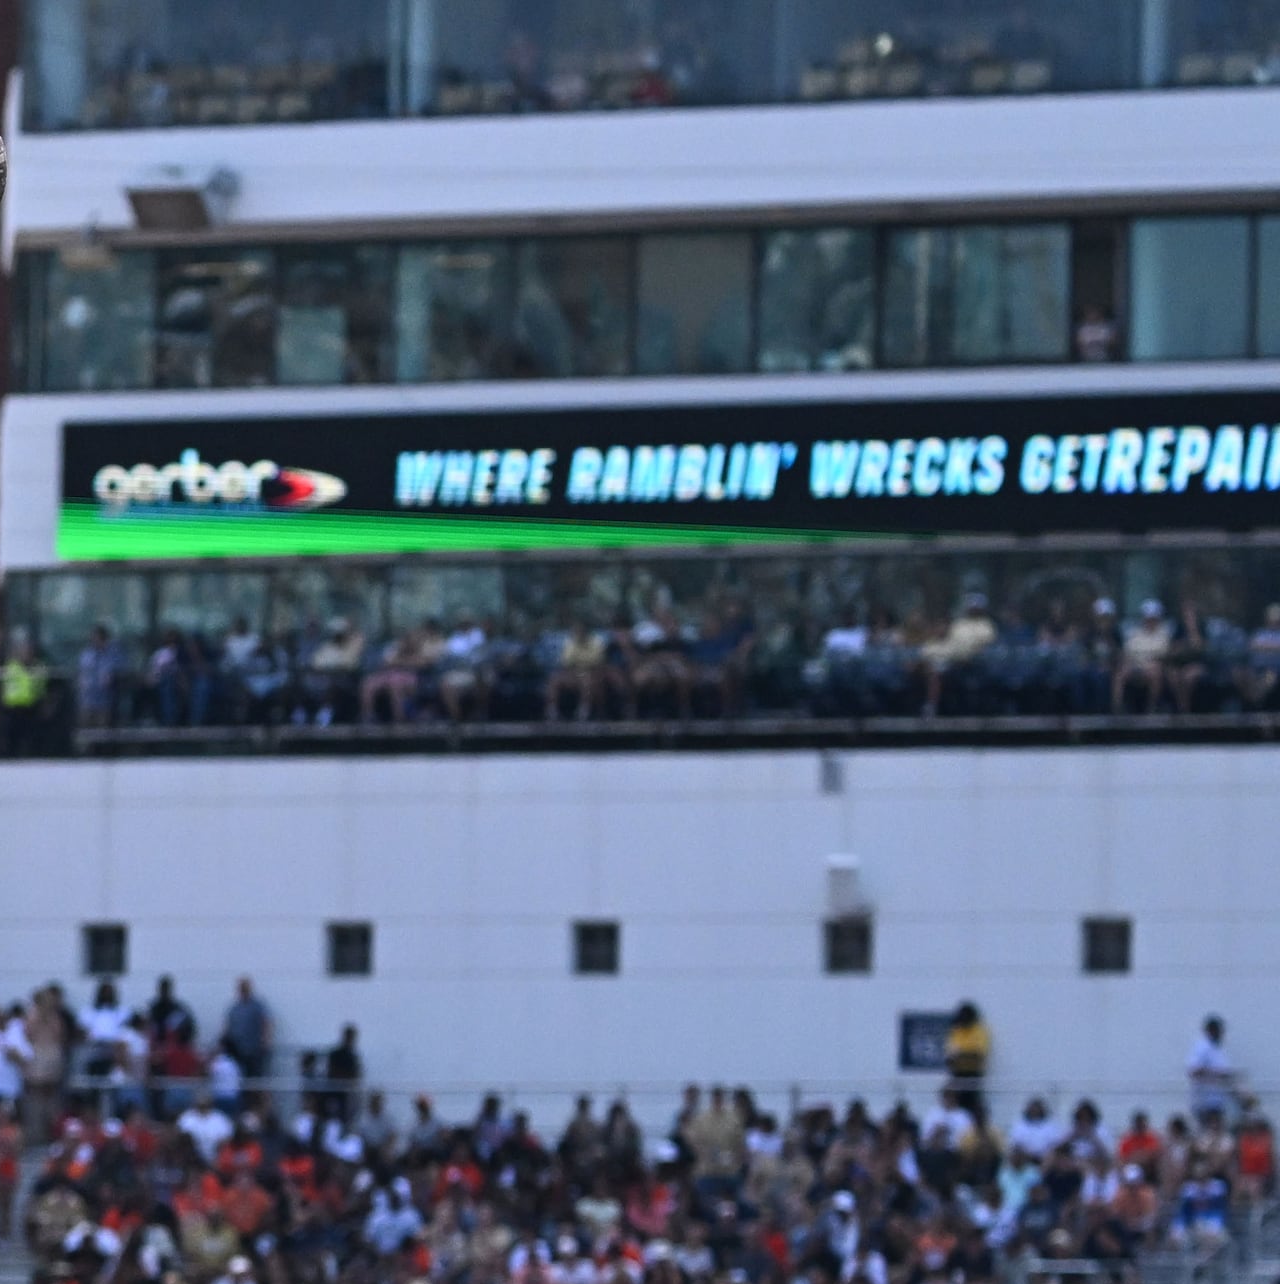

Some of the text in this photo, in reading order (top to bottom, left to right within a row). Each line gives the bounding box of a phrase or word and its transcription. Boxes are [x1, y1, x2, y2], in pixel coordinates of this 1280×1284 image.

[94, 447, 278, 518] gerber
[395, 447, 556, 506] WHERE
[808, 434, 1008, 501] WRECKS
